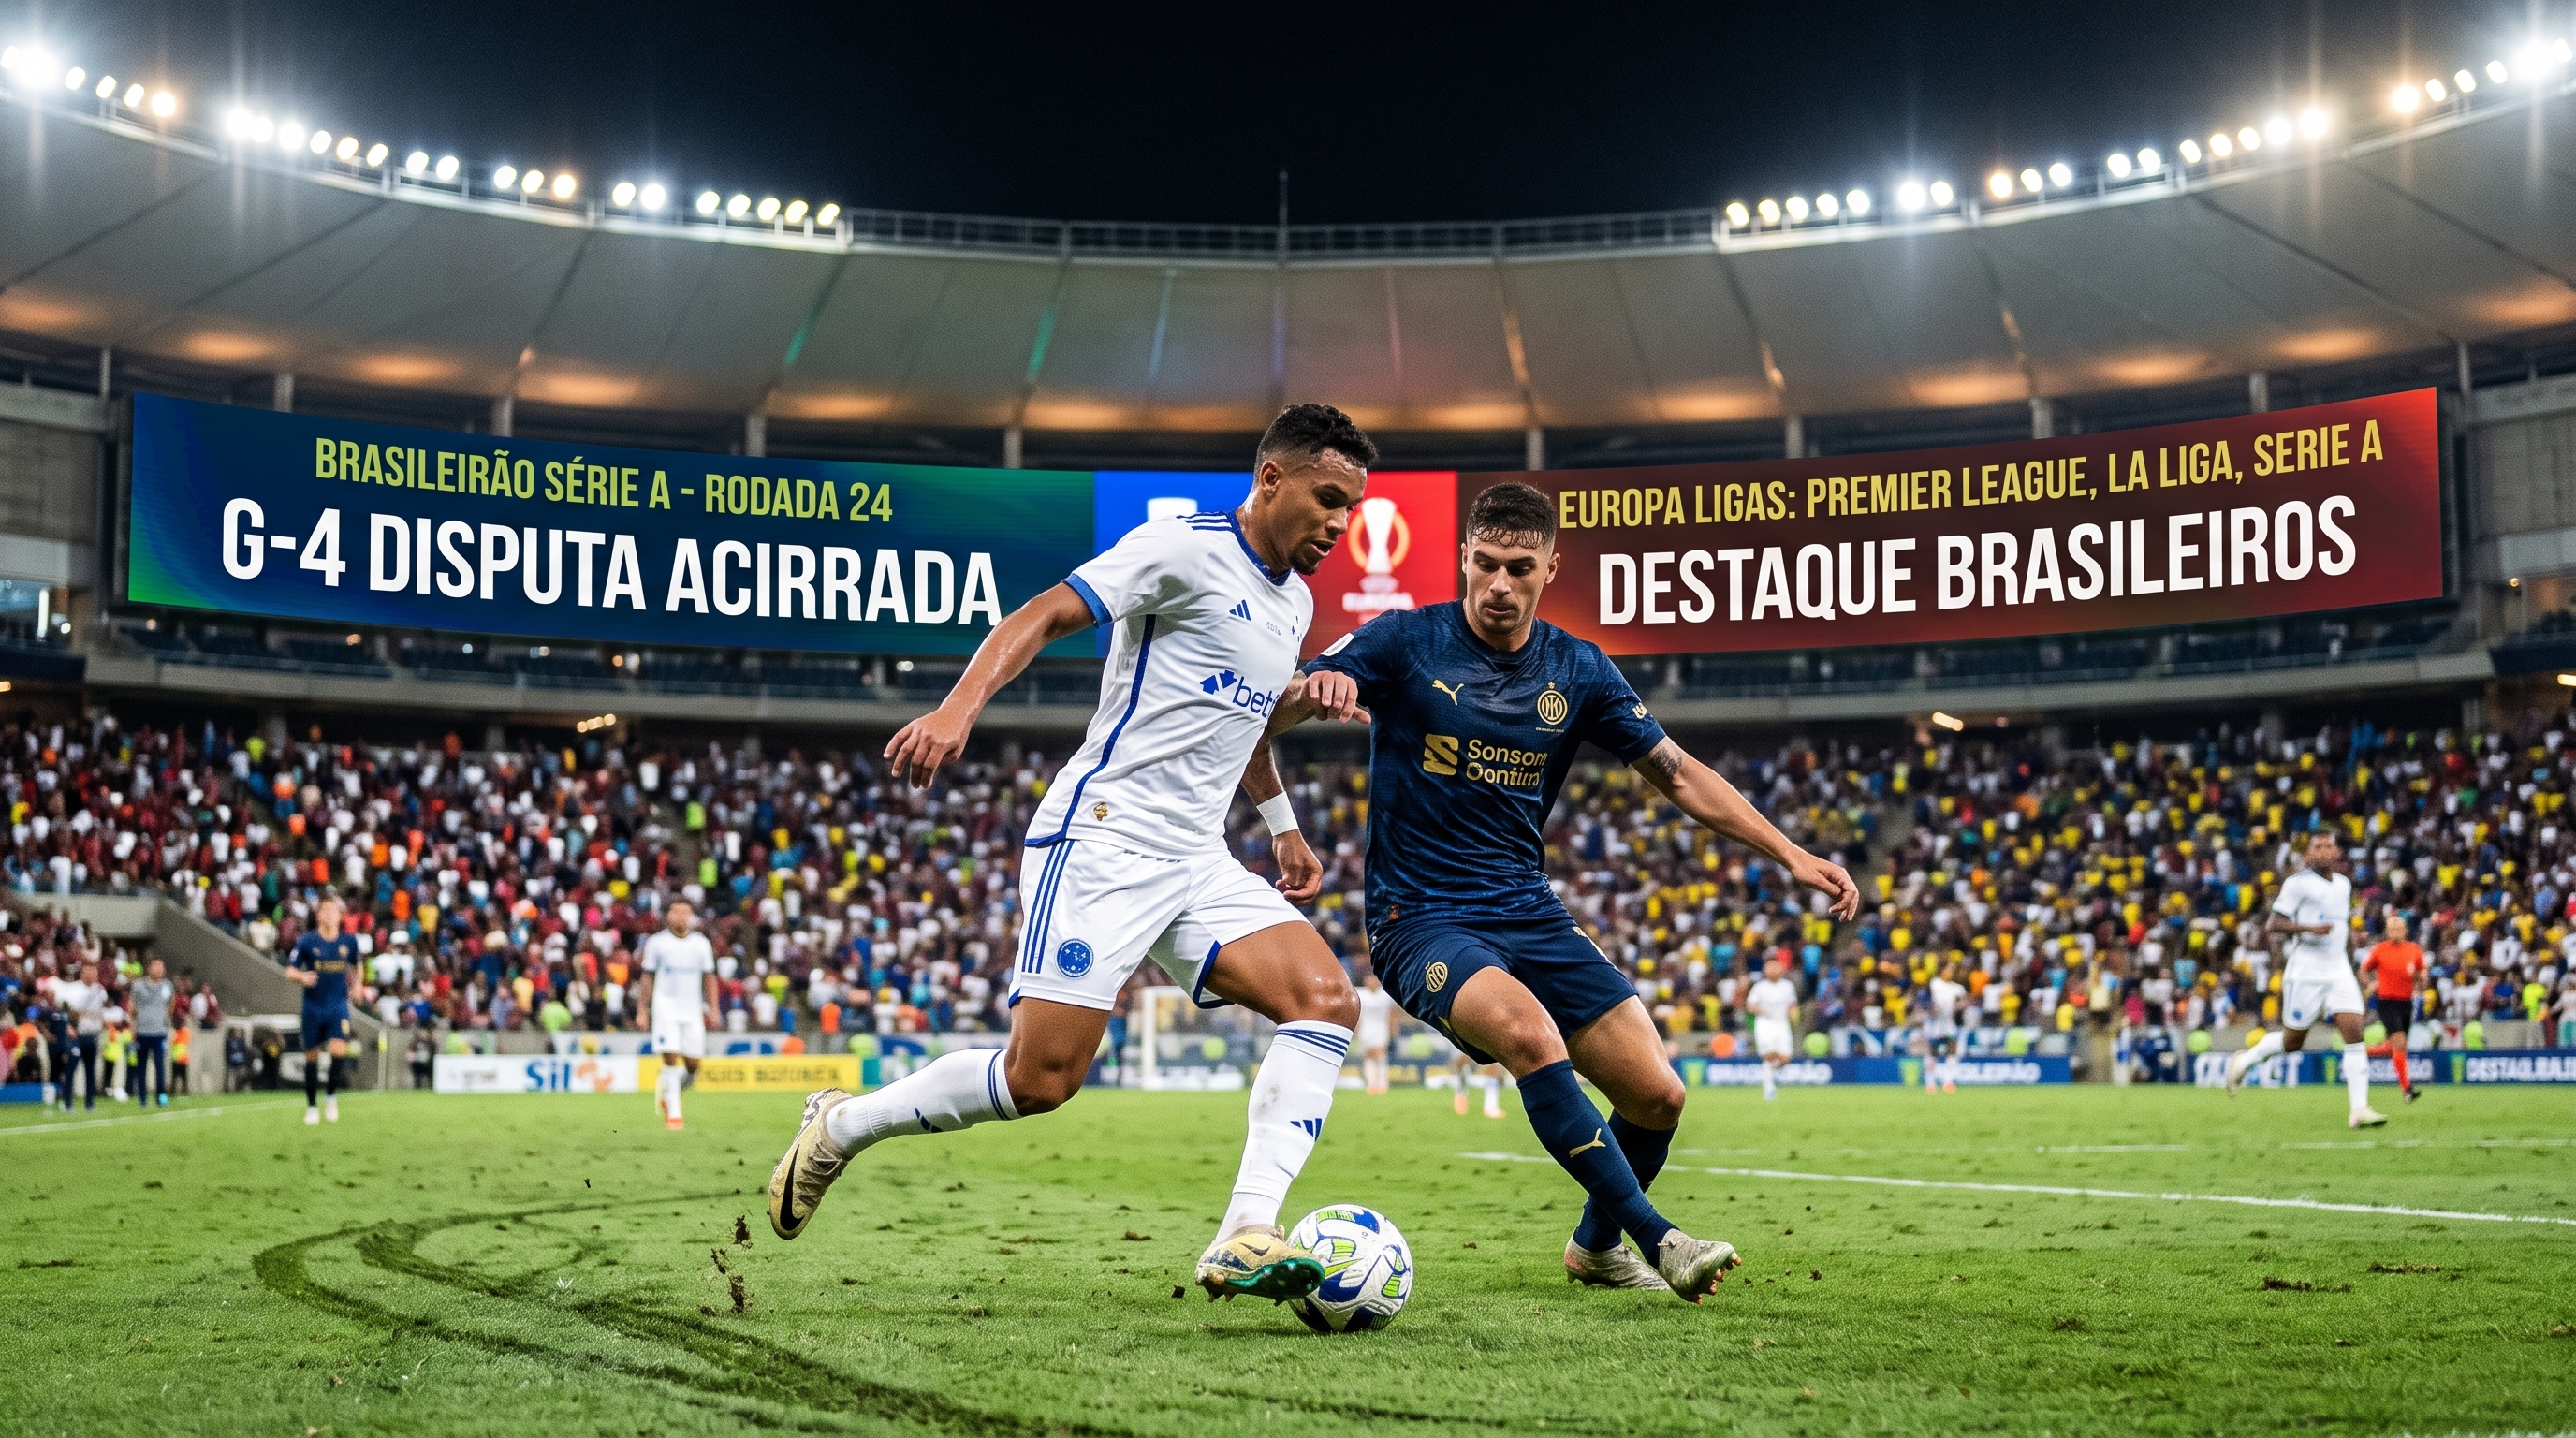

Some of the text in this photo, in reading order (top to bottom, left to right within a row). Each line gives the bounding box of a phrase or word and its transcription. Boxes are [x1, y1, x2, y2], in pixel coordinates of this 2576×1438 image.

[316, 438, 534, 498] BRASILEIRÃO
[546, 456, 639, 507] SÉRIE
[650, 471, 671, 509] A
[706, 475, 840, 519] RODADA
[850, 483, 892, 521] 24
[1559, 420, 2383, 528] EUROPA LIGAS: PREMIER LEAGUE, LA LIGA, SERIE A
[222, 497, 1002, 626] G-4 DISPUTA ACIRRADA
[1599, 496, 2356, 624] DESTAQUE BRASILEIROS
